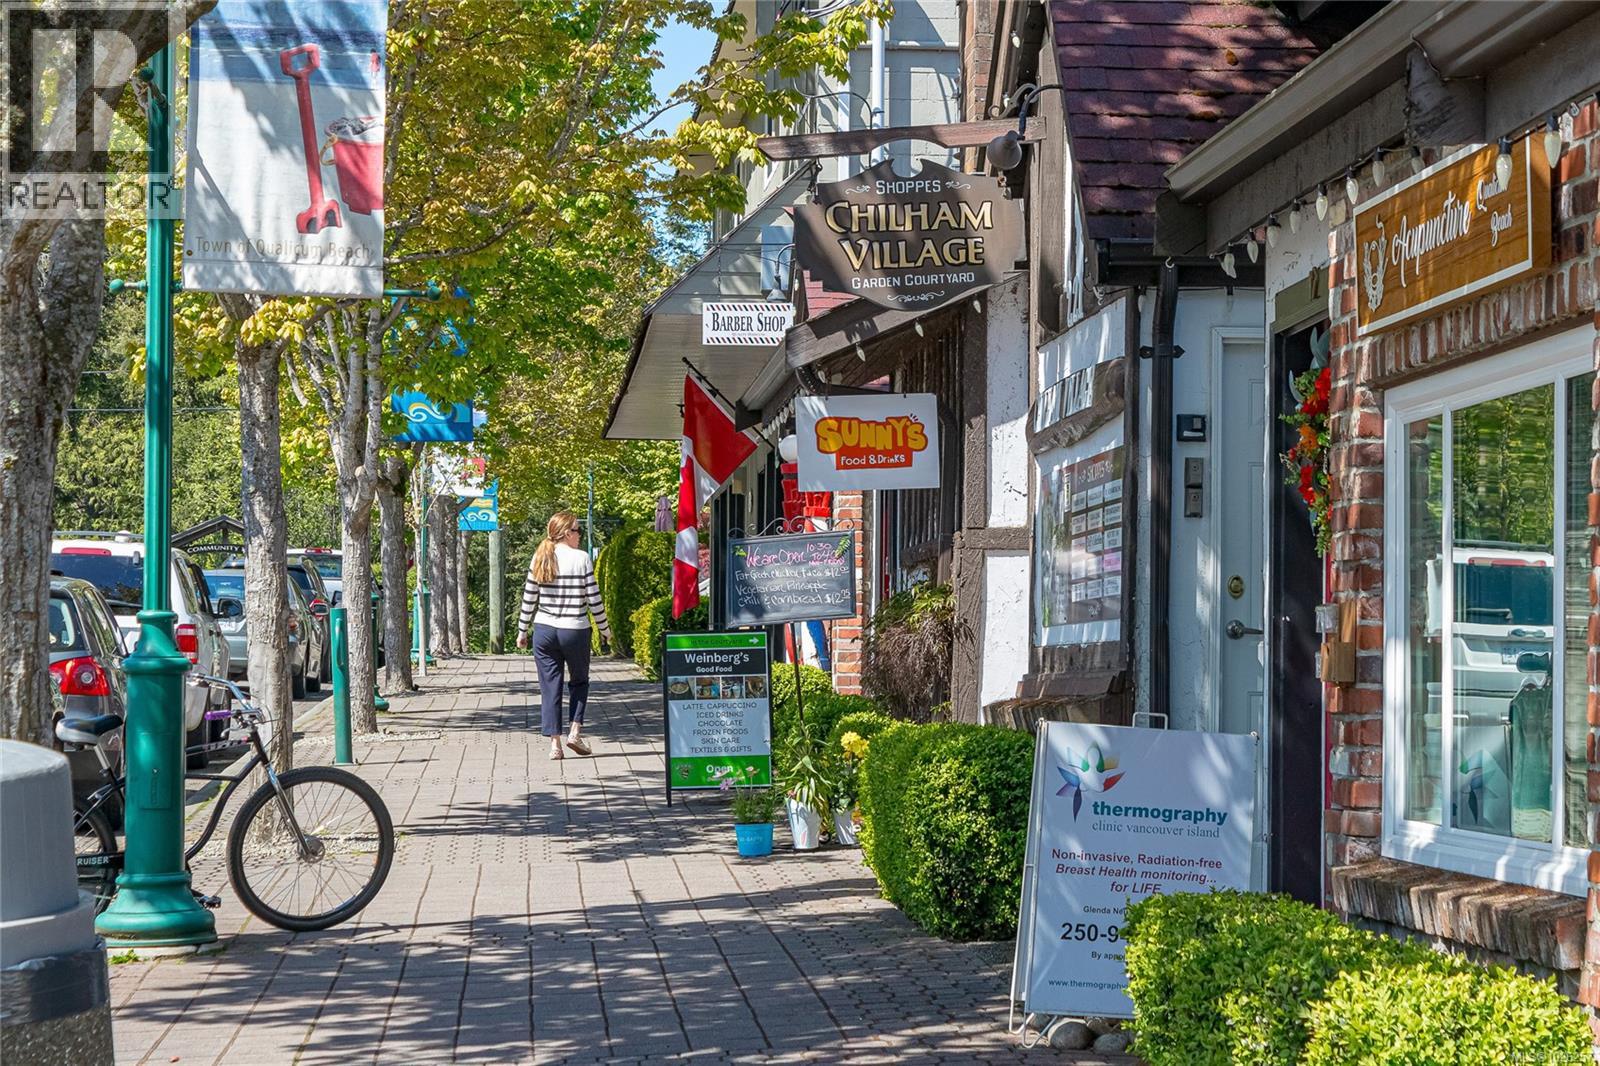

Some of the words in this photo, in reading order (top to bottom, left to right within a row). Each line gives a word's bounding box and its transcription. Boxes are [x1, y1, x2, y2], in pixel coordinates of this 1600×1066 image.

[876, 180, 941, 194] SHOPPES
[825, 200, 993, 233] CHILHAM
[1391, 190, 1472, 288] Acupuncture
[197, 236, 232, 252] Town
[238, 239, 251, 253] of
[256, 239, 323, 257] Qualicum
[328, 242, 370, 259] Beach
[840, 237, 986, 272] VILLAGE
[851, 275, 901, 290] GARDEN
[904, 272, 975, 287] COURTYARD
[711, 312, 754, 332] BARBER
[757, 312, 786, 332] SHOP
[816, 417, 927, 453] SUNNY'S
[840, 455, 866, 466] Food
[868, 454, 876, 465] &
[187, 545, 240, 554] COMMUNITY
[684, 652, 750, 665] Weinberg's
[715, 665, 733, 673] Food
[706, 702, 757, 710] CAPPUCCINO
[696, 711, 714, 719] ICED
[715, 710, 744, 718] DRINKS
[693, 728, 720, 736] FROZEN
[701, 737, 719, 745] SKIN
[706, 764, 734, 774] Open
[1092, 800, 1228, 826] thermography
[1091, 819, 1122, 833] clinic
[1126, 823, 1184, 836] vancouver
[1187, 825, 1220, 838] island
[77, 856, 109, 866] RUISER
[1052, 848, 1134, 865] Non-invasive,
[1137, 853, 1223, 869] Radiation-free
[1055, 863, 1096, 876] Breast
[1098, 866, 1137, 878] Health
[1140, 870, 1217, 884] monitoring...
[1110, 881, 1128, 893] for
[1131, 882, 1162, 895] LIFE
[1083, 905, 1111, 914] Glenda
[1061, 922, 1128, 943] 250-9
[1091, 951, 1102, 960] By
